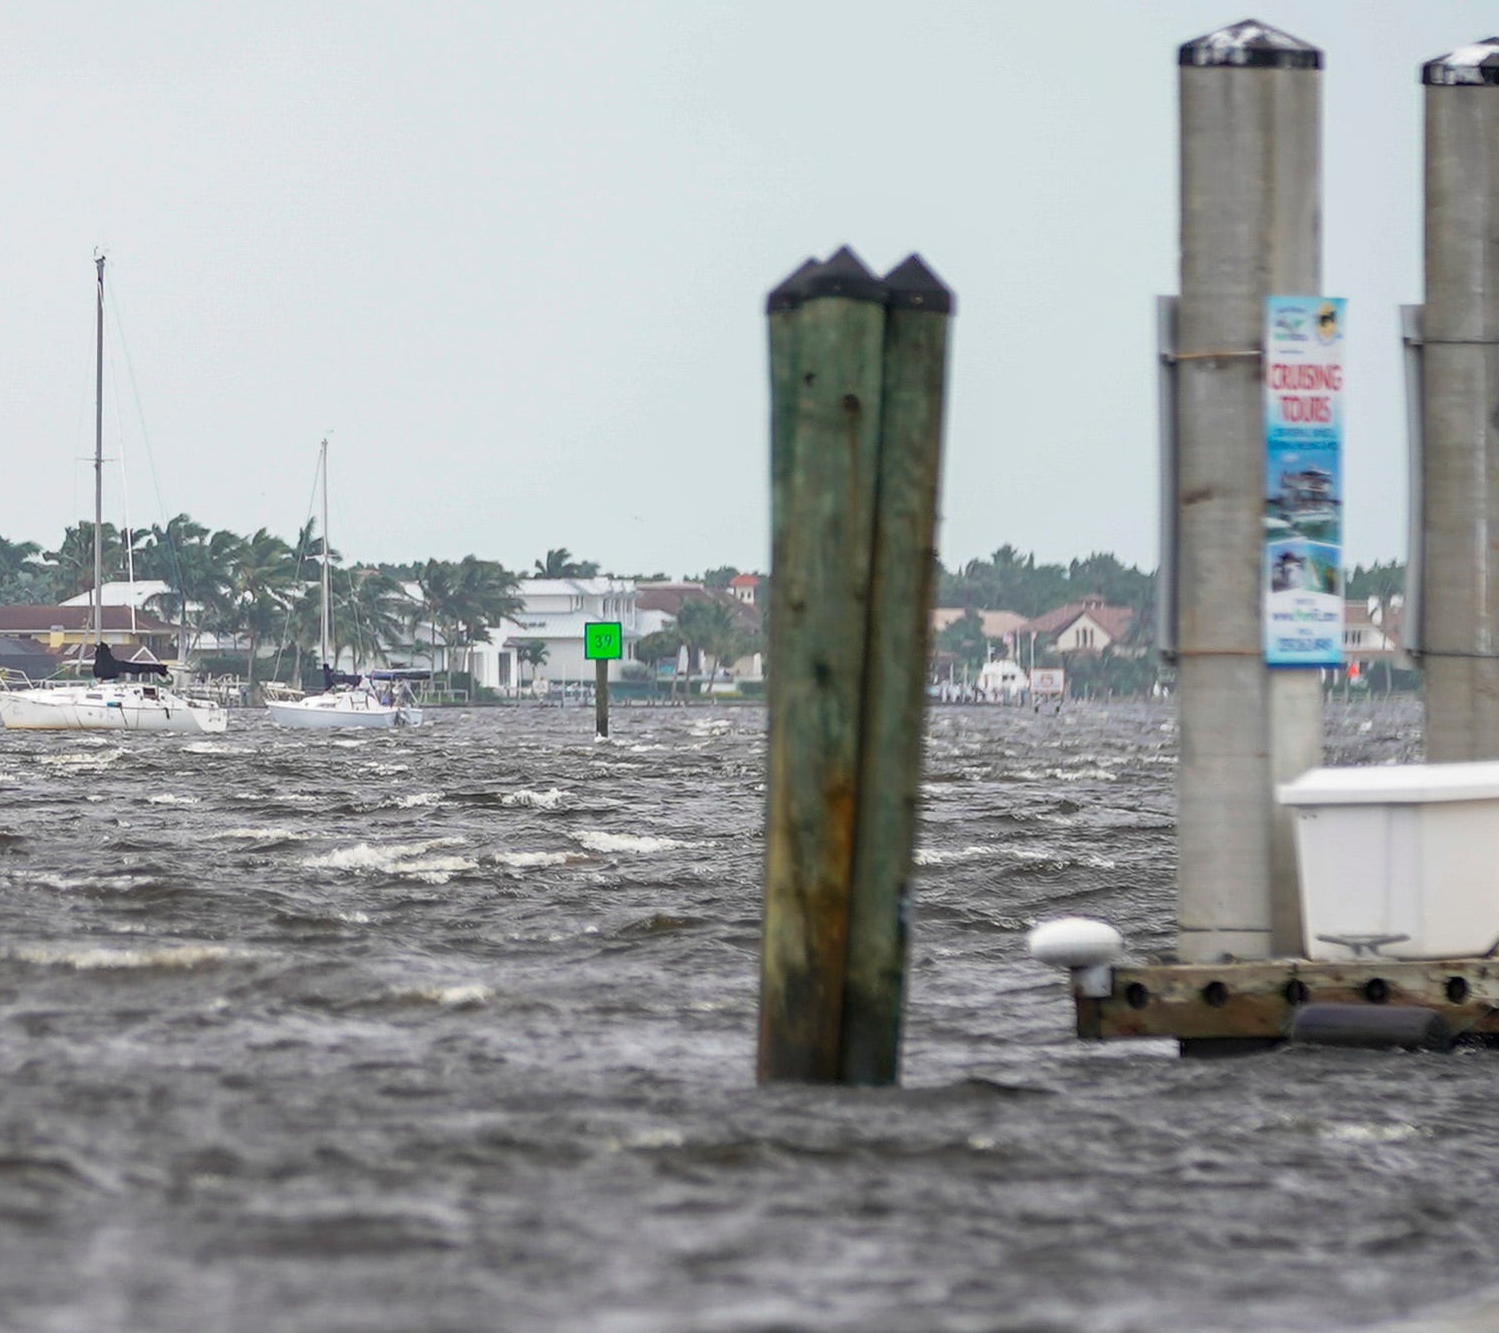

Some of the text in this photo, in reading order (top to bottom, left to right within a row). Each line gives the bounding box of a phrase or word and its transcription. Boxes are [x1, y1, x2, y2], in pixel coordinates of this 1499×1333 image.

[1269, 363, 1343, 391] CRUISING
[1279, 396, 1332, 422] TOURS
[595, 634, 612, 649] 39
